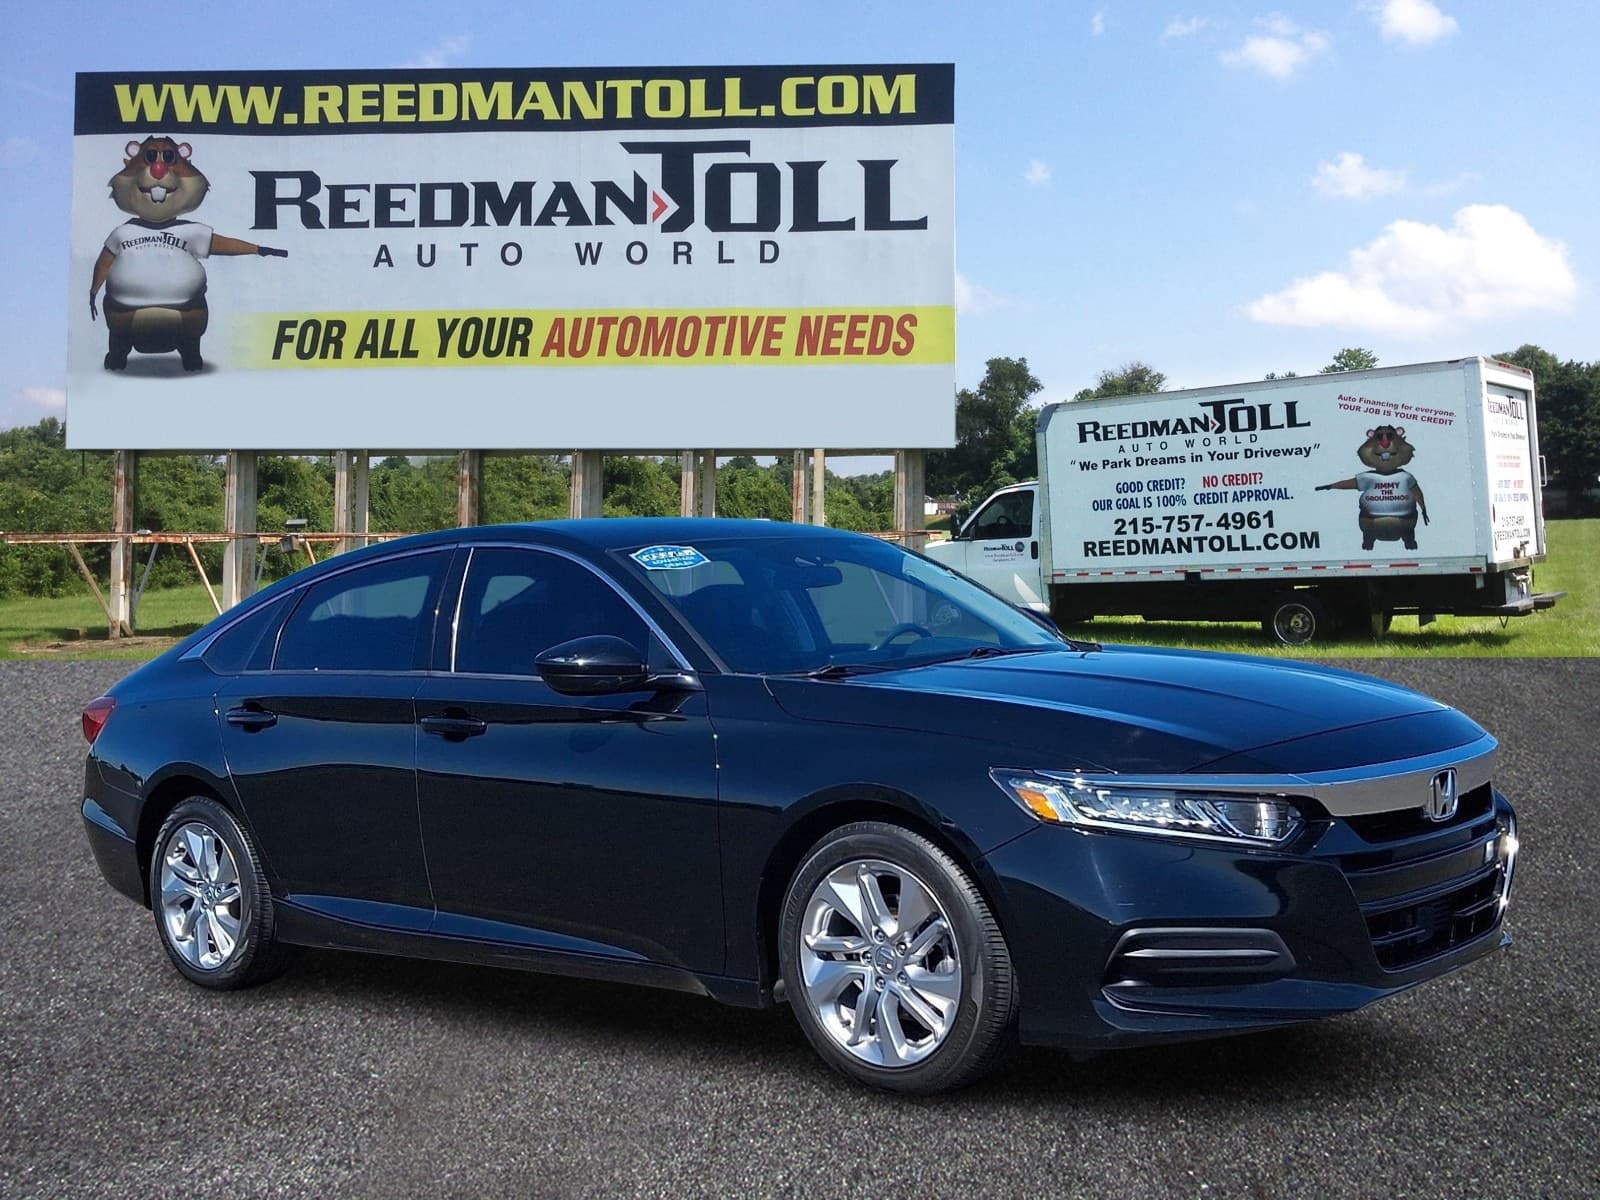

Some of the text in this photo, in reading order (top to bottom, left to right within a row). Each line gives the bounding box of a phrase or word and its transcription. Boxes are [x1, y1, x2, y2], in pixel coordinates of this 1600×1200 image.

[114, 73, 917, 125] WWW.REEDMANTOLL.COM
[373, 239, 781, 268] AUTO WORLD
[272, 313, 918, 360] FOR ALL YOUR AUTOMOTIVE NEEDS
[1338, 394, 1457, 418] Auto Financing for everyone.
[1338, 403, 1454, 426] YOUR JOB IS YOUR CREDIT
[1118, 433, 1258, 454] AUTO WORLD
[1102, 458, 1132, 470] Park
[1135, 455, 1187, 467] Dreams
[1191, 452, 1203, 463] in
[1208, 450, 1239, 462] Your
[1115, 477, 1185, 494] GOOD CREDIT?
[1202, 472, 1263, 489] NO CREDIT?
[1092, 487, 1294, 512] OUR GOAL IS 100% CREDIT APPROVAL.
[1114, 510, 1275, 536] 215-757-4961
[1083, 531, 1321, 558] REEDMANTOLL.COM
